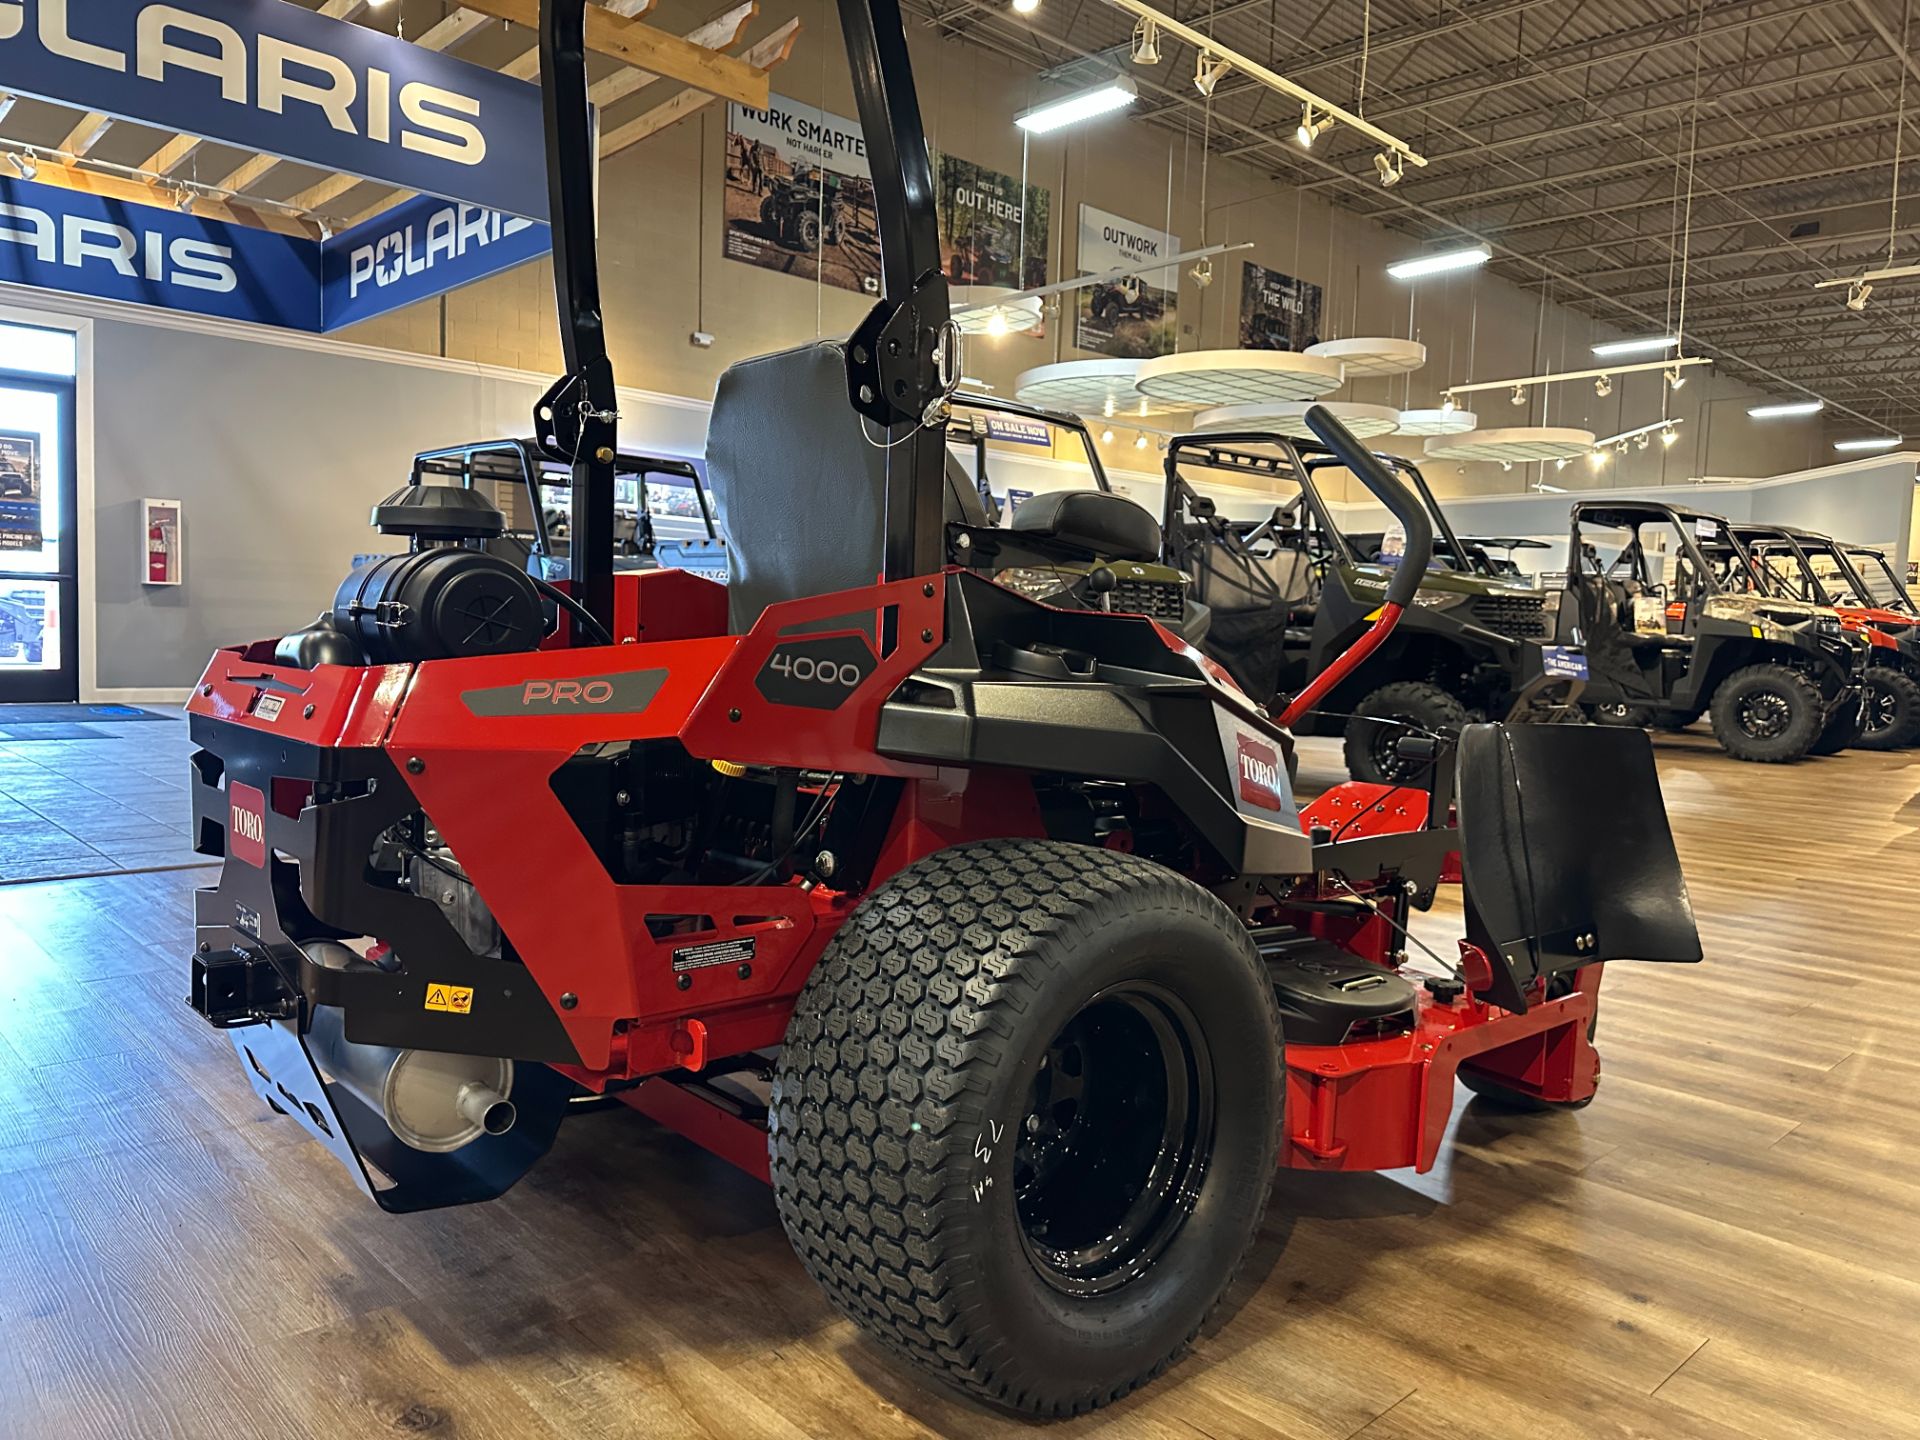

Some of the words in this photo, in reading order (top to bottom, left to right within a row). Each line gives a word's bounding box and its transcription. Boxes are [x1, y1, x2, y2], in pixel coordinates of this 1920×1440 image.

[0, 0, 487, 165] LARIS
[742, 105, 792, 133] WORK
[798, 119, 868, 158] SMARTE
[786, 137, 801, 150] NOT
[956, 187, 984, 210] OUT
[987, 196, 1021, 223] HERE
[1103, 226, 1158, 257] OUTWORK
[1263, 290, 1280, 308] THE
[1281, 295, 1303, 314] WILD
[991, 420, 1003, 431] ON
[1004, 422, 1027, 434] SALE
[1027, 426, 1046, 437] NOW
[770, 653, 860, 686] 4000
[522, 681, 614, 705] PRO
[1240, 754, 1276, 789] TORO
[232, 805, 263, 843] TORO
